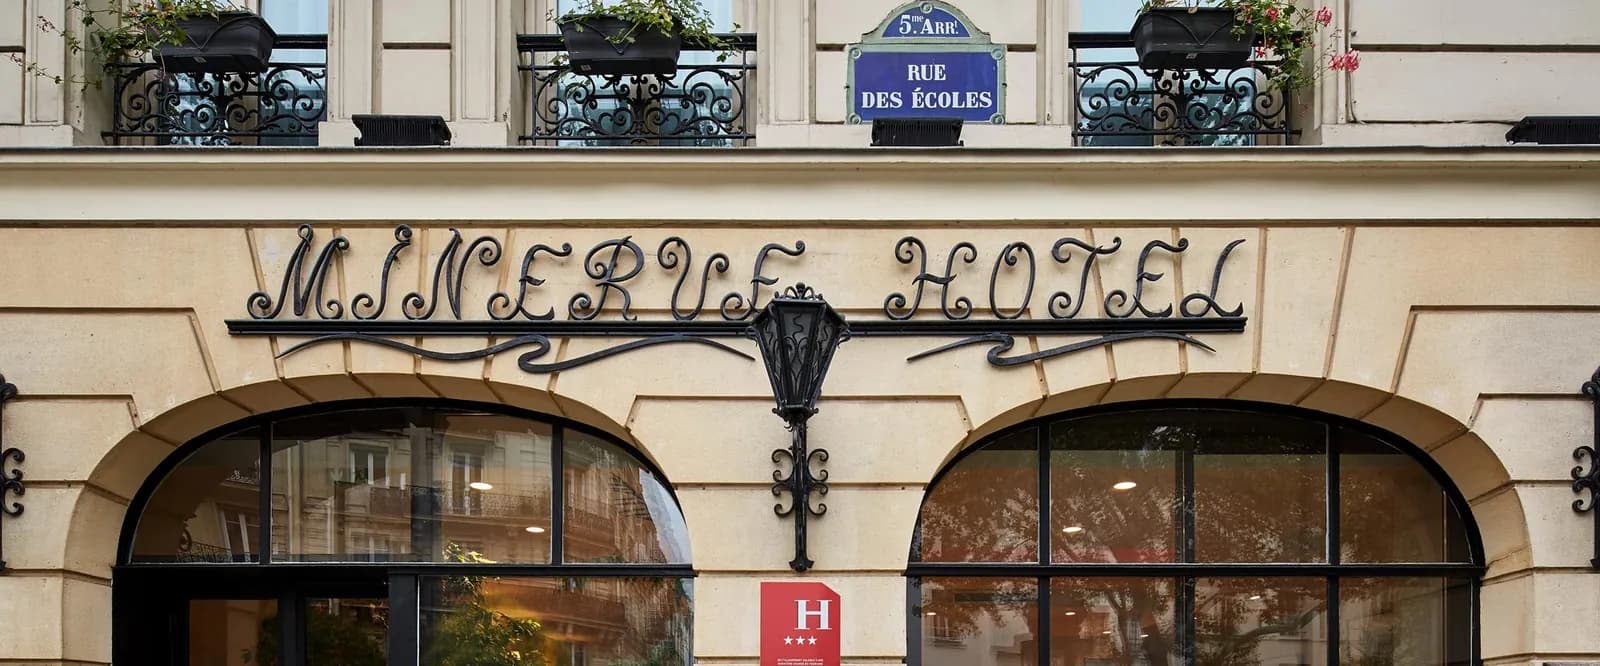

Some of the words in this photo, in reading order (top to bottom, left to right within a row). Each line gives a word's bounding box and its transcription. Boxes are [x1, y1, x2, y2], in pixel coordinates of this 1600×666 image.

[907, 64, 946, 81] RUE
[861, 91, 903, 109] DES
[911, 87, 993, 109] ÉCOLES
[884, 236, 1246, 321] HOTEL
[794, 599, 833, 630] H
